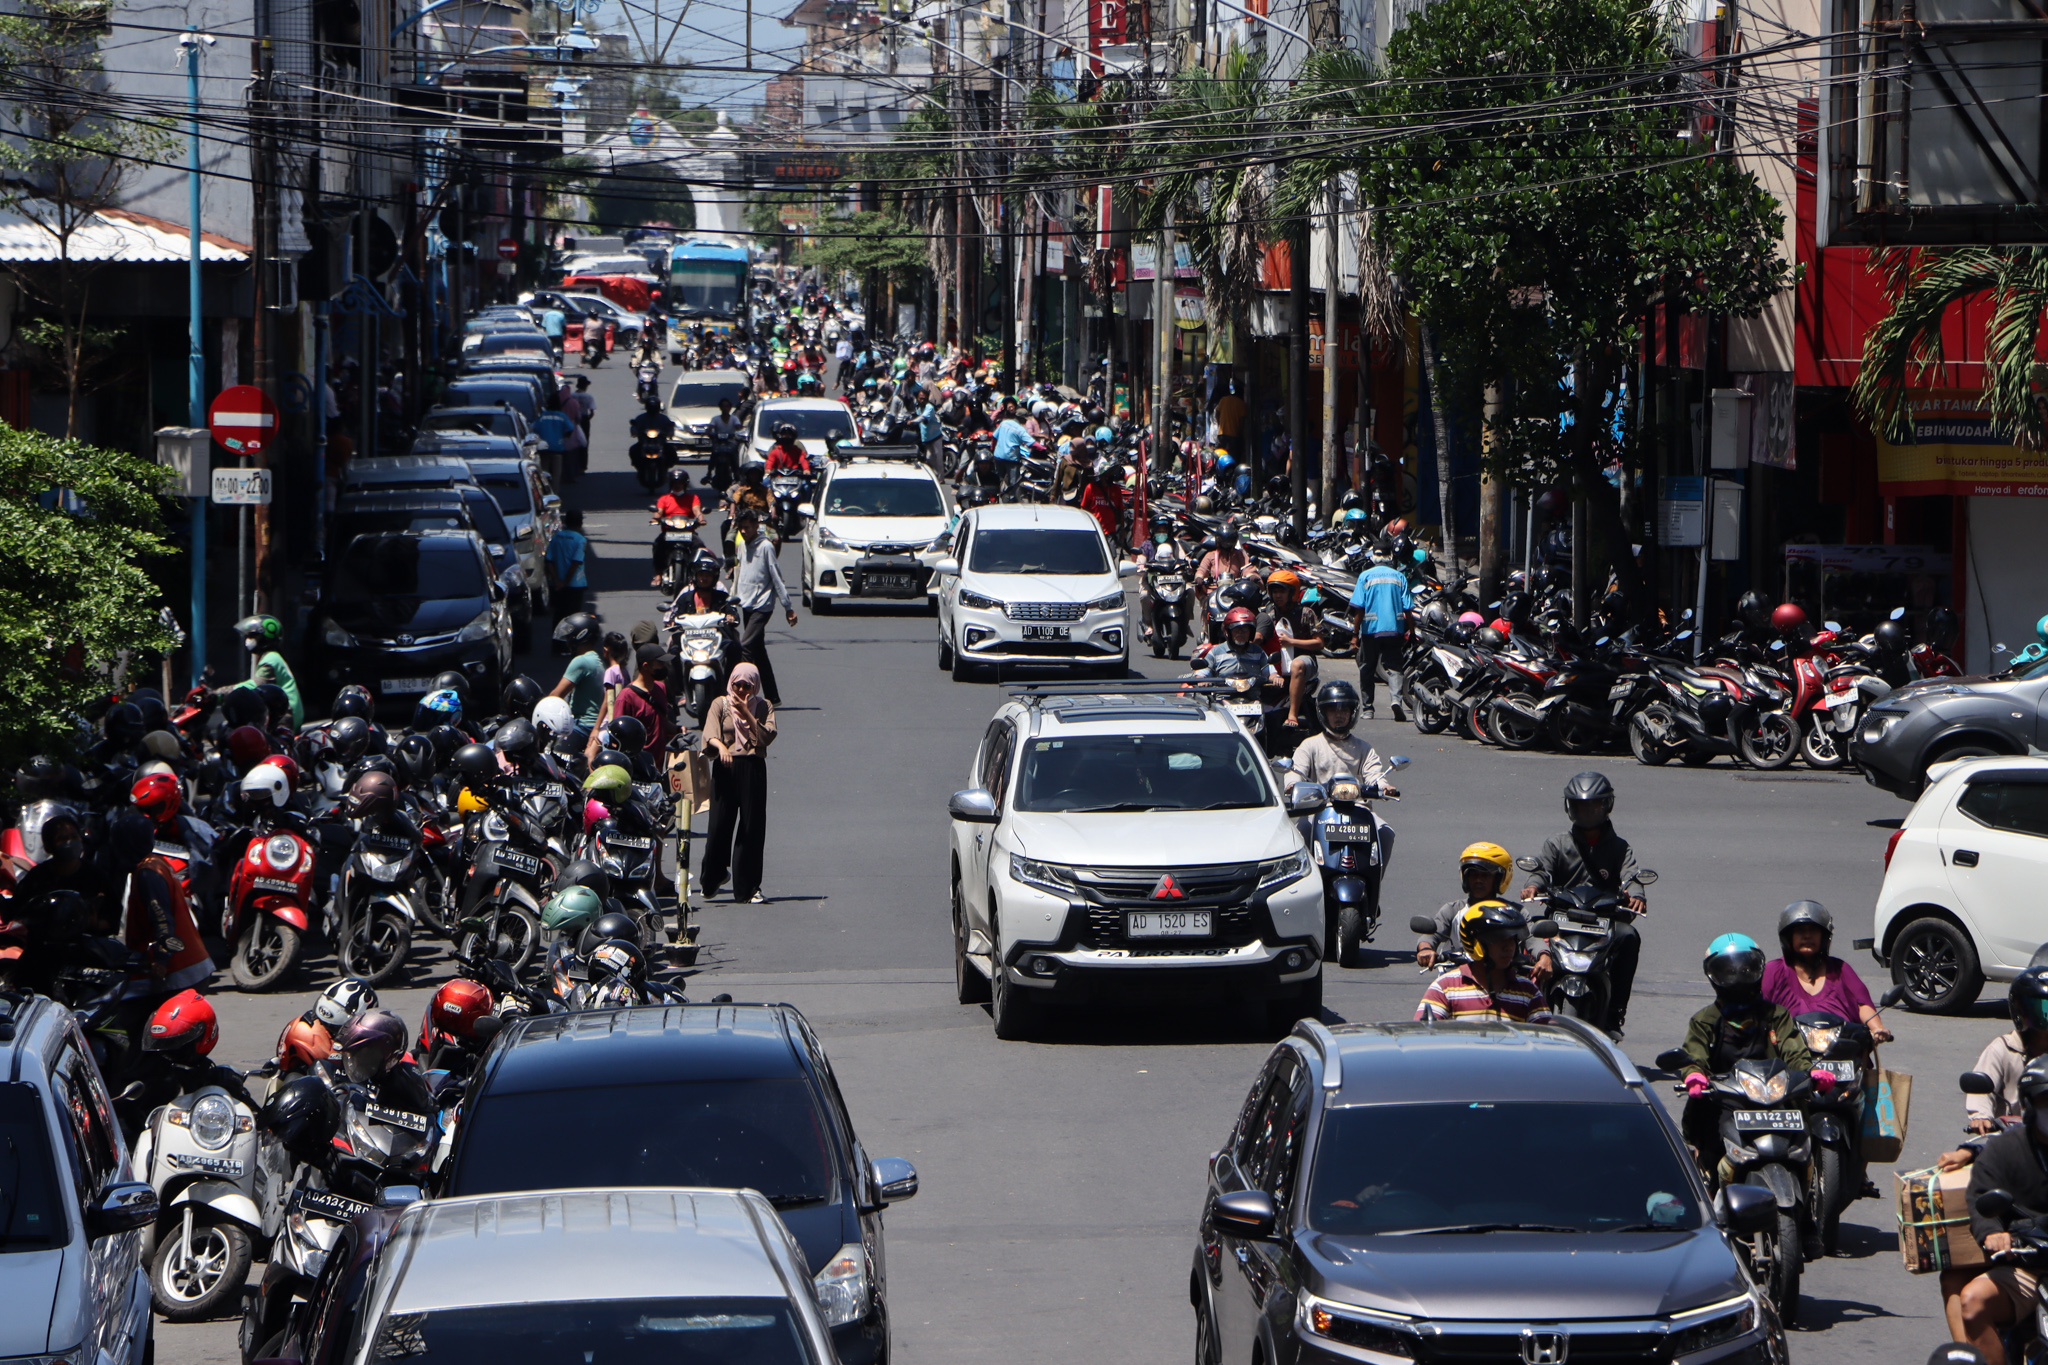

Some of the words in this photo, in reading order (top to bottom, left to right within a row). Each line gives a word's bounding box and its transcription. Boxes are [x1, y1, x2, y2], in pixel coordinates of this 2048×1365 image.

[1980, 456, 2012, 469] hingga
[2015, 457, 2022, 466] 5
[1975, 485, 2001, 495] Hanya
[2003, 485, 2011, 494] di
[1879, 556, 1926, 570] 79
[1023, 626, 1033, 636] AD
[1037, 626, 1055, 636] 1109
[1325, 825, 1336, 833] AD
[1338, 825, 1356, 833] 4260
[1132, 915, 1147, 929] AD
[1158, 914, 1186, 929] 1520
[1193, 914, 1209, 928] ES
[367, 1103, 380, 1112] AD
[383, 1105, 408, 1119] 3819
[1737, 1112, 1751, 1121] AD
[1755, 1112, 1782, 1121] 6122
[222, 1159, 242, 1168] ATB
[305, 1190, 319, 1201] AD
[319, 1194, 346, 1210] 4134
